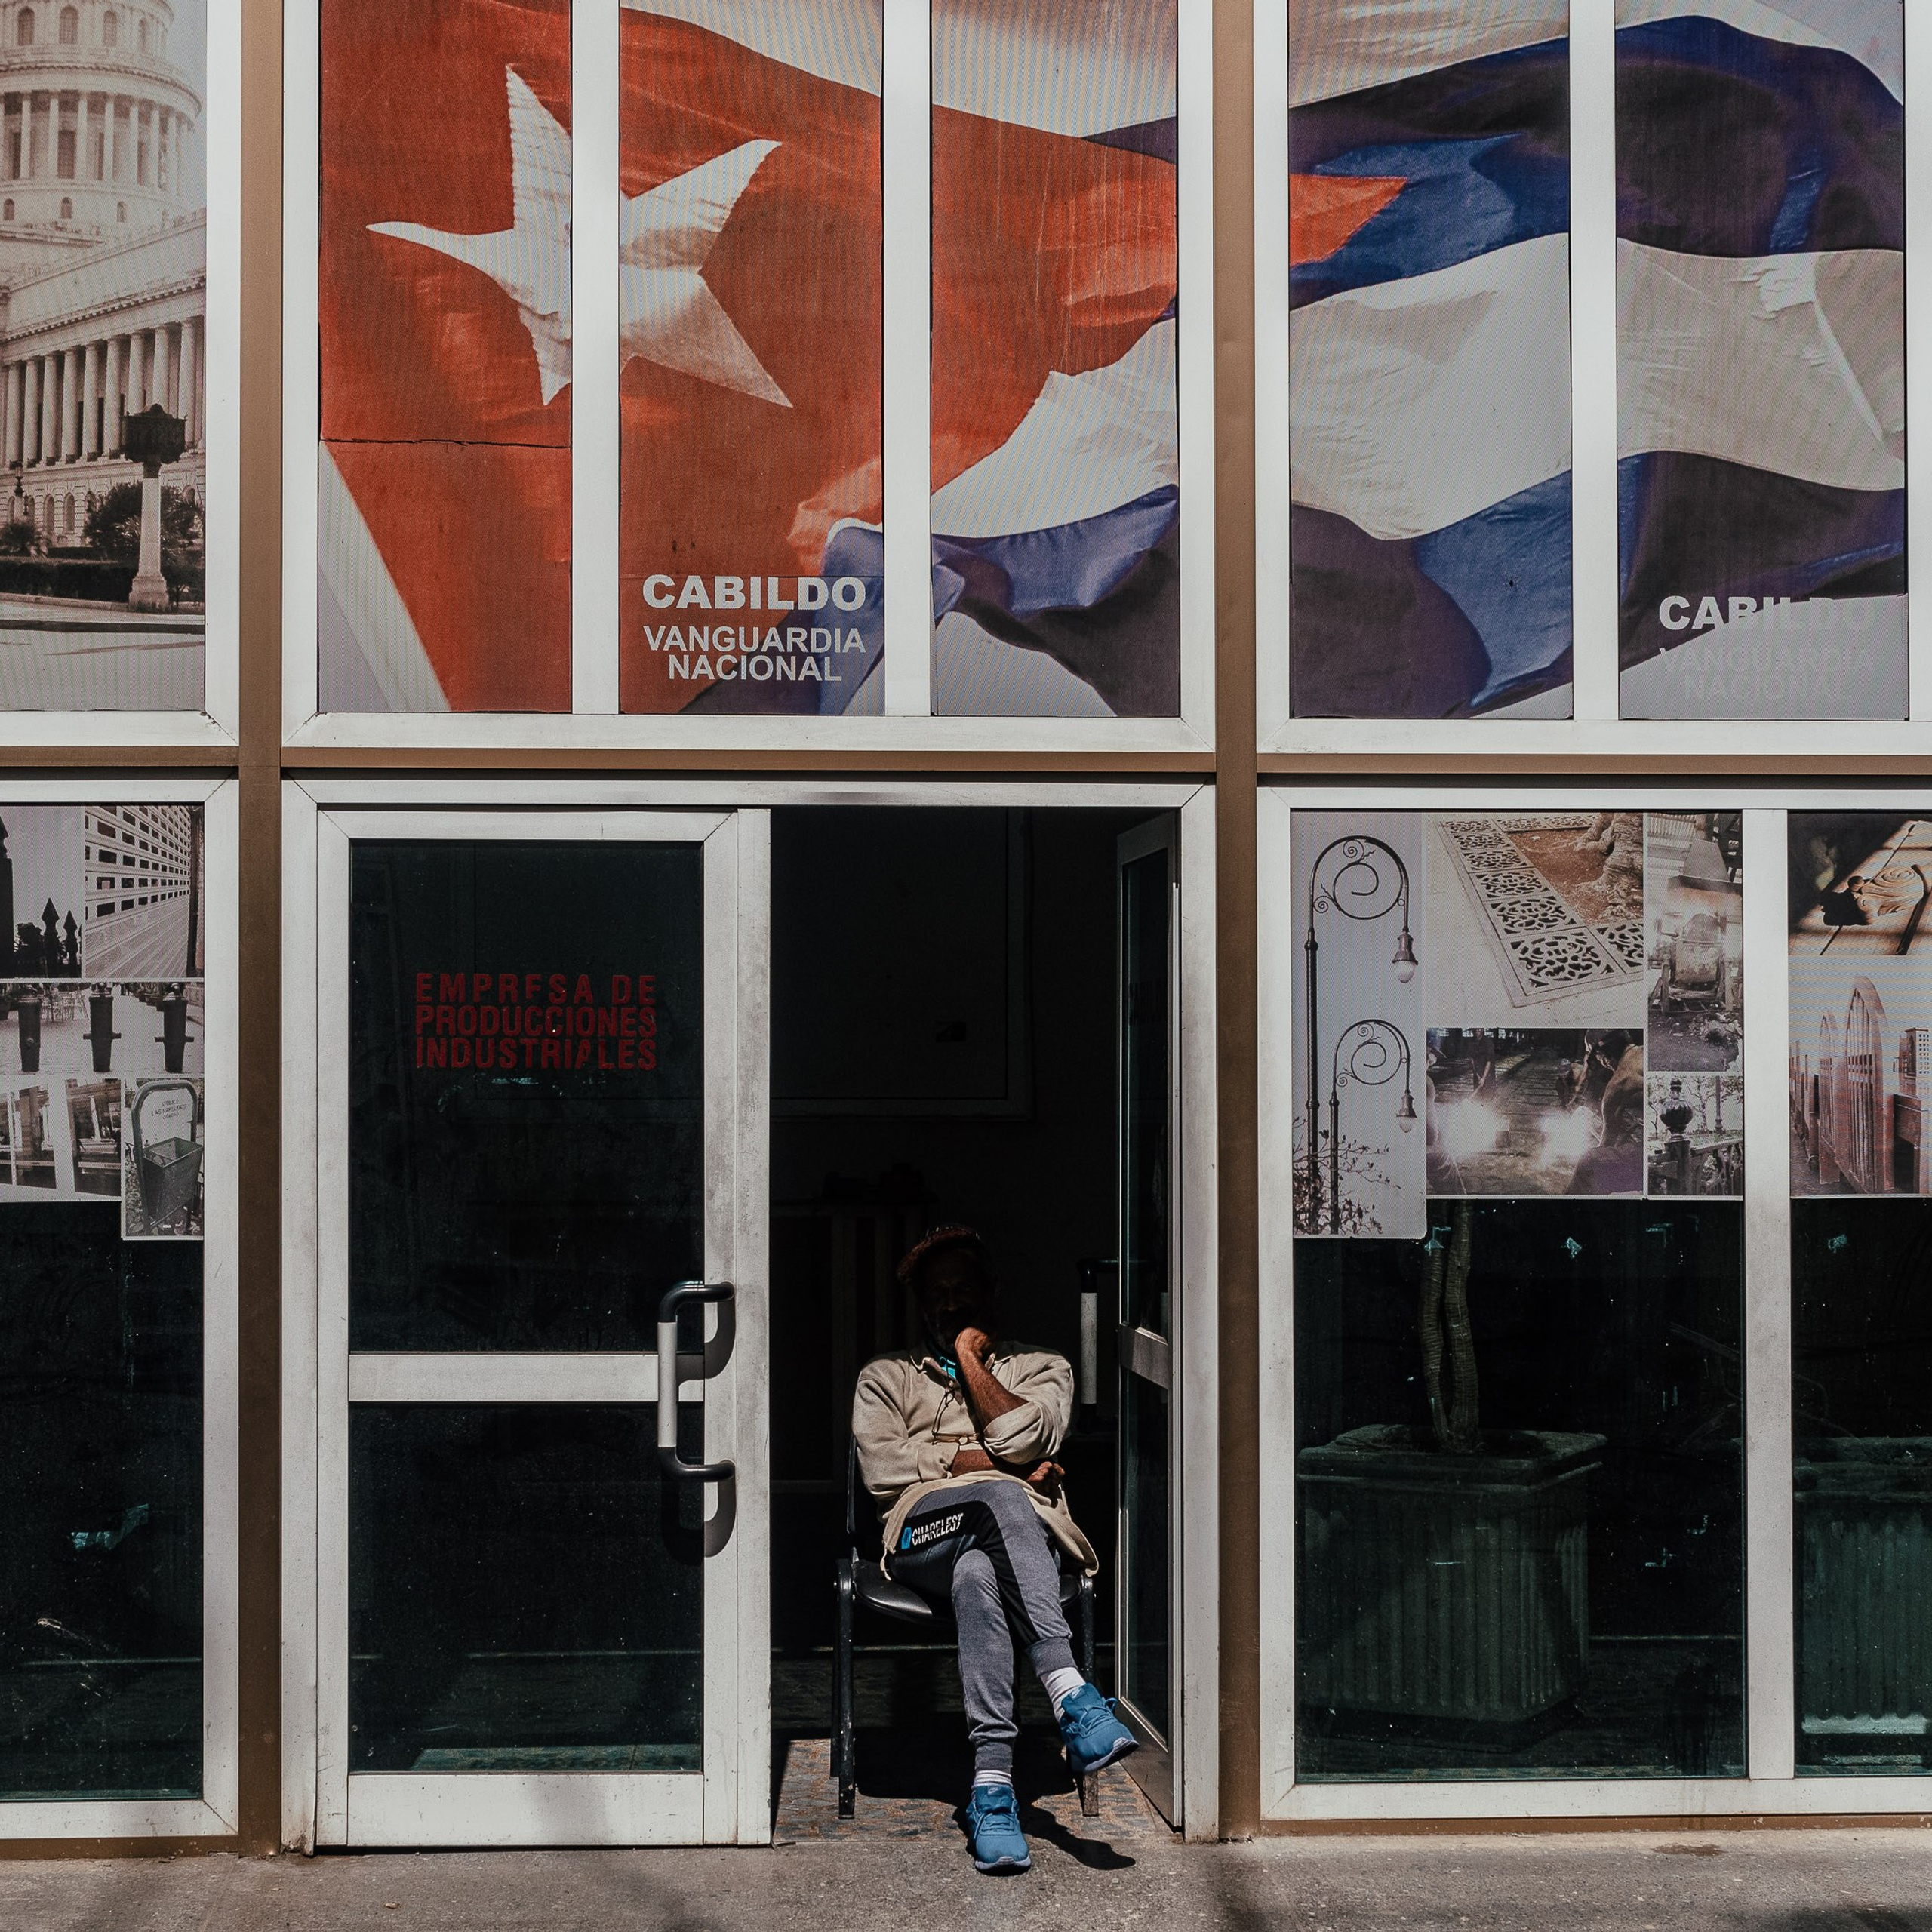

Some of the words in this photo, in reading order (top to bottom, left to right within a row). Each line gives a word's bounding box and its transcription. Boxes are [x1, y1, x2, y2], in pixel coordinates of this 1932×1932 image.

[642, 574, 866, 611] CABILDO
[643, 626, 866, 653] VANGUARDIA
[669, 654, 842, 681] NACIONAL
[612, 975, 655, 1004] DE
[416, 1005, 657, 1037] PRODUCCIONES
[416, 1038, 657, 1070] INDUSTRIALES
